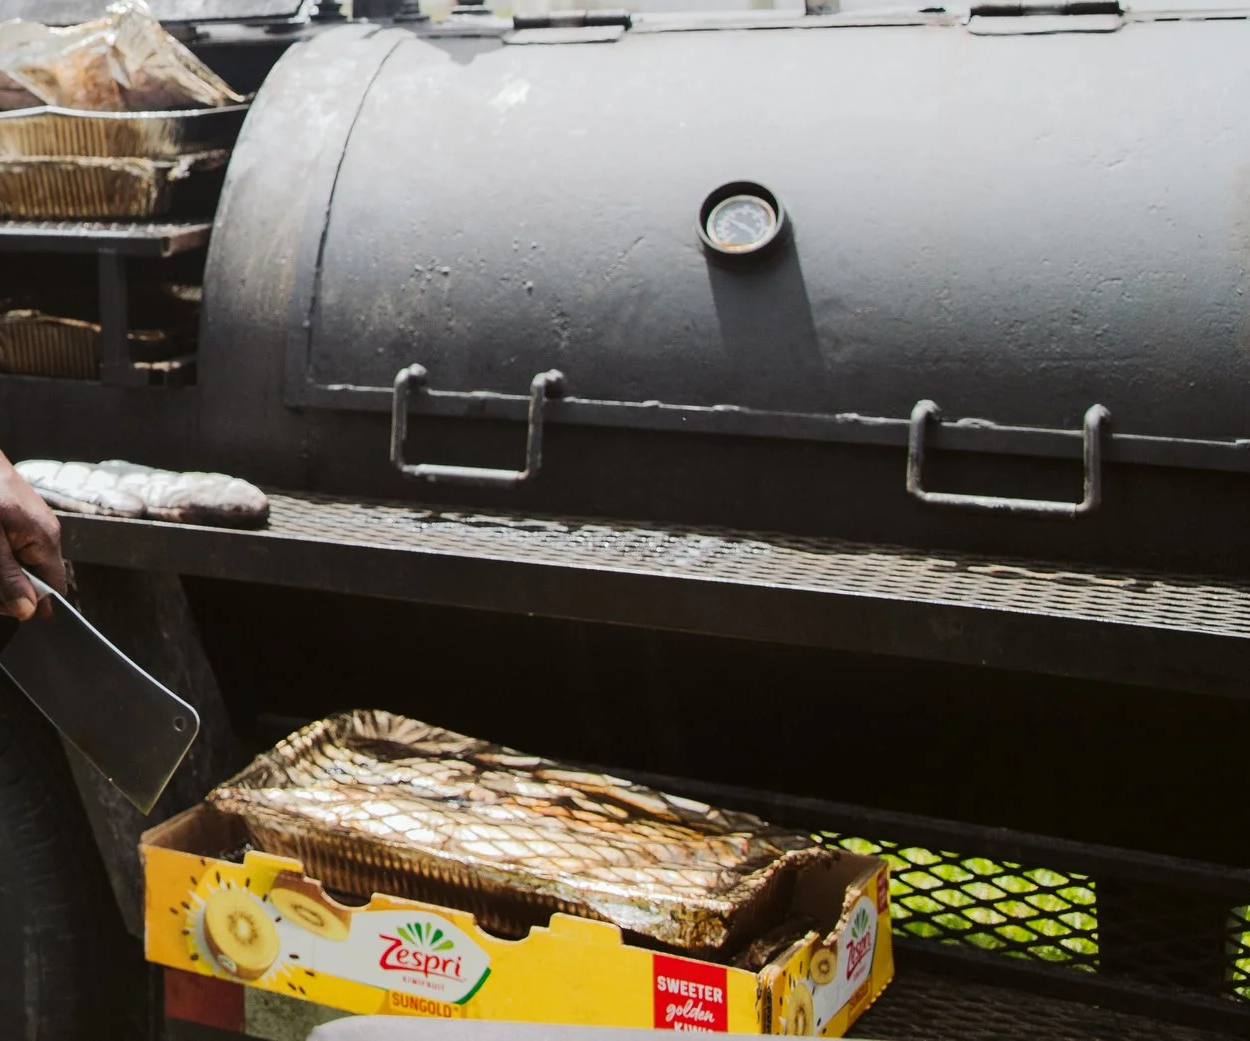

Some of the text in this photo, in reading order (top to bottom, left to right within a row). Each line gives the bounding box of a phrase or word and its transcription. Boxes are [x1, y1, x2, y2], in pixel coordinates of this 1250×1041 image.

[379, 934, 468, 983] Zespri
[657, 975, 723, 1004] SWEETER
[665, 998, 715, 1023] golden
